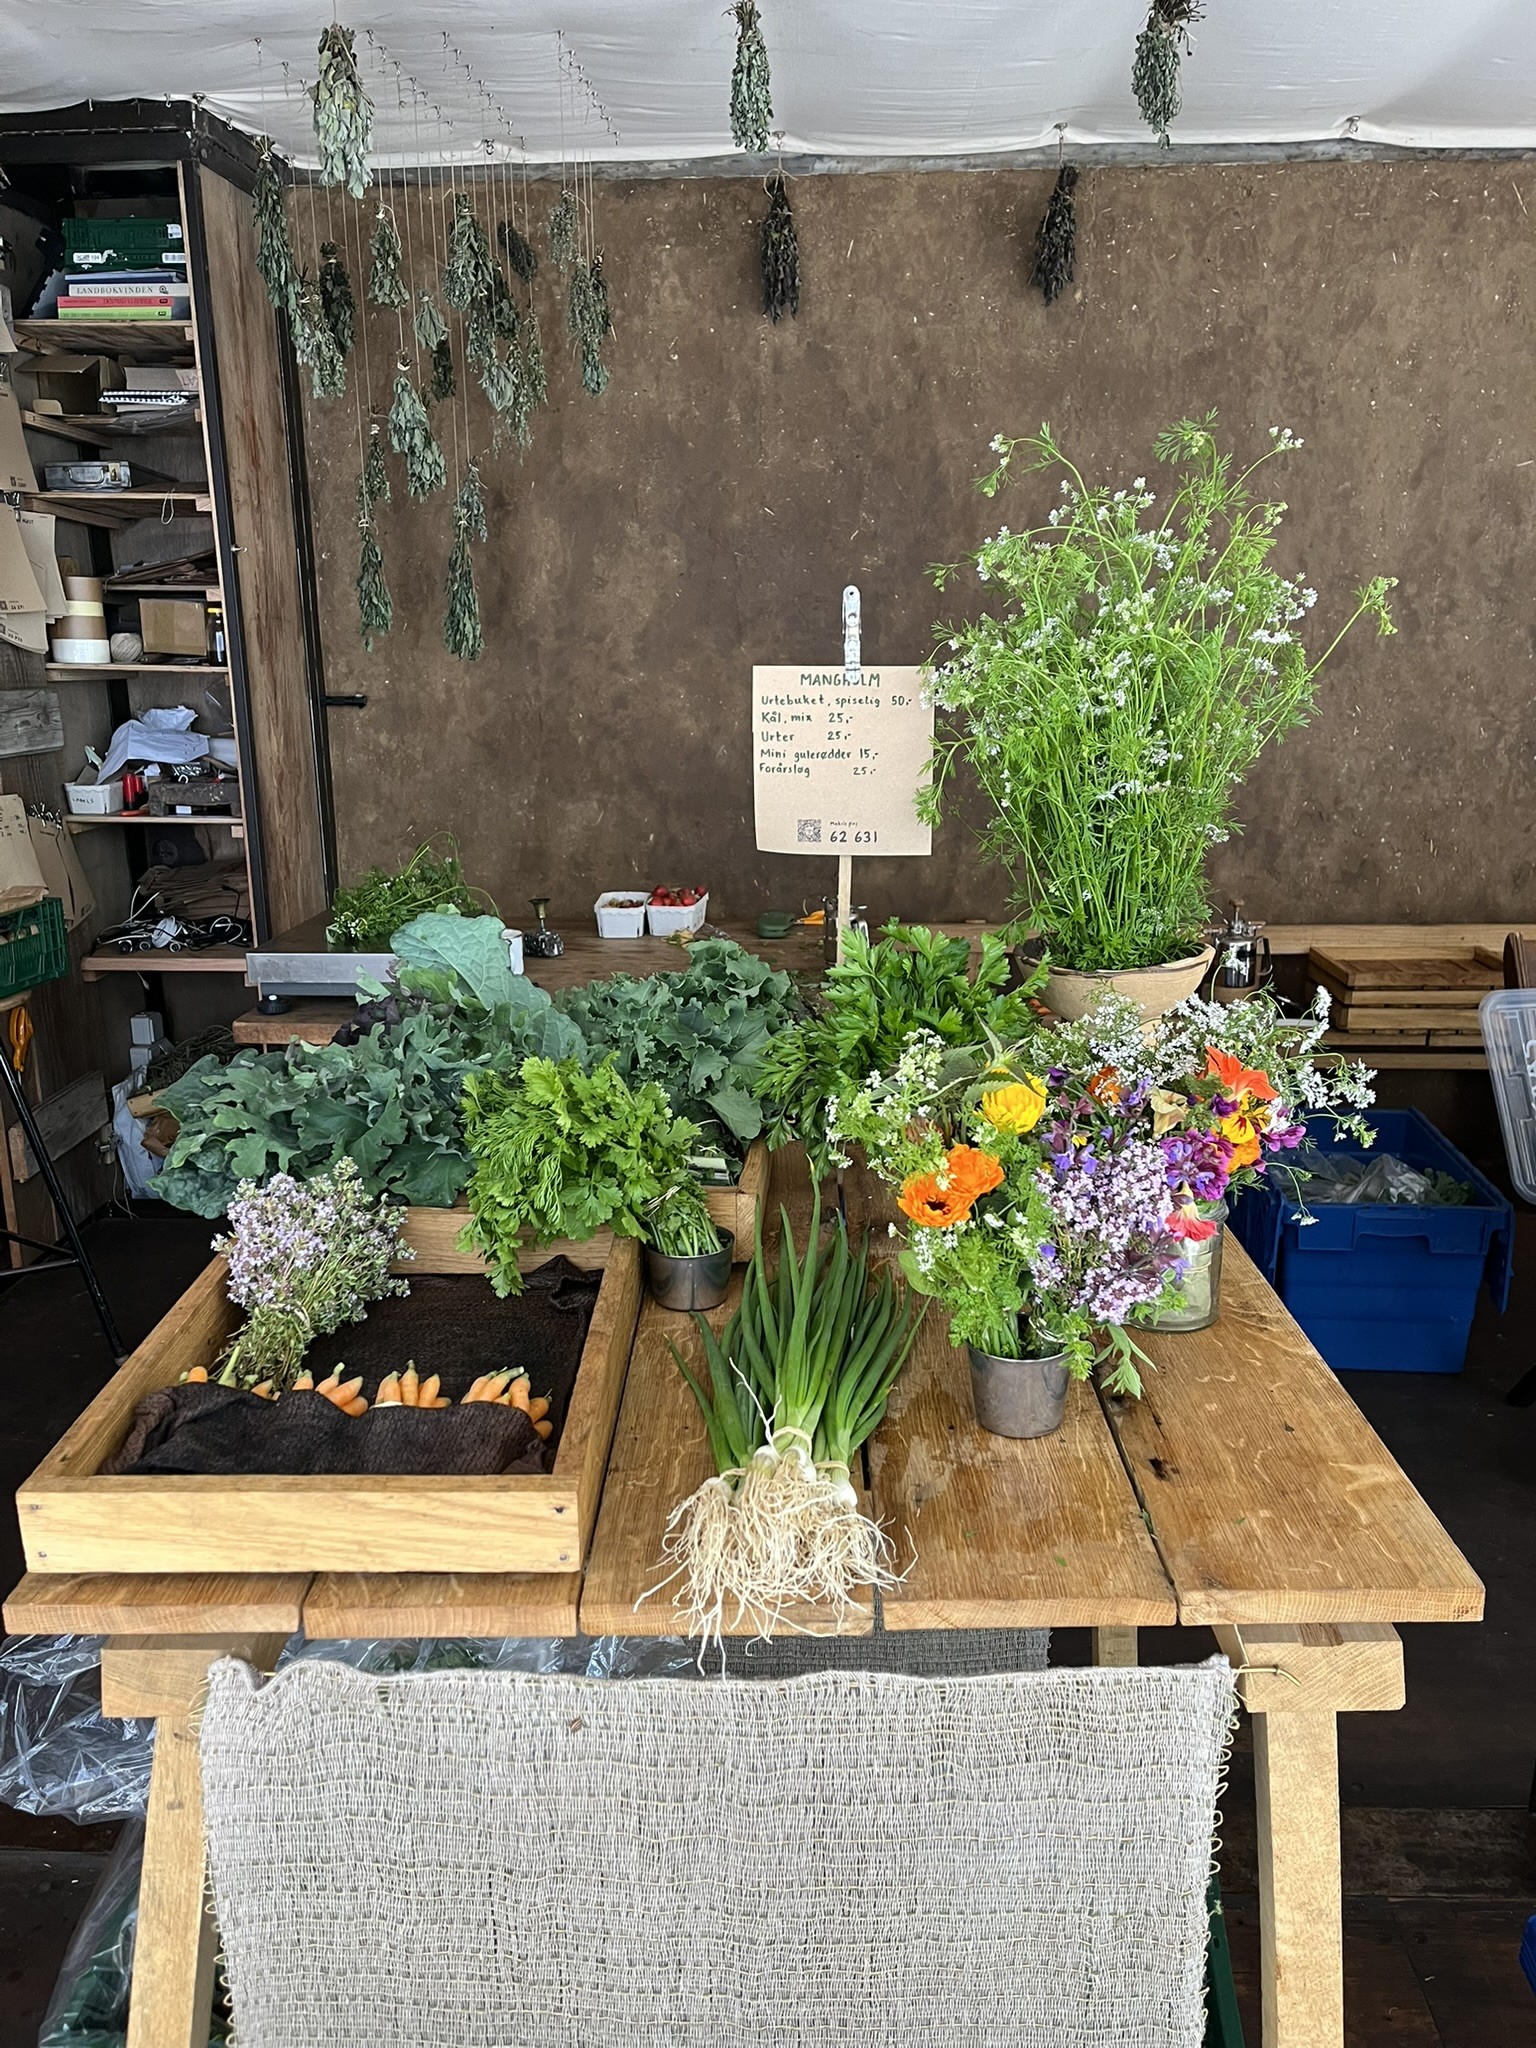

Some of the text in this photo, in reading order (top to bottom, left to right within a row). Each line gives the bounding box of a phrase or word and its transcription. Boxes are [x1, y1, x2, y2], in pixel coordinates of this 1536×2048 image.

[76, 286, 153, 294] LANDBOKVINDEN
[835, 695, 880, 708] spiselig
[791, 712, 812, 722] mix
[761, 731, 795, 742] Urter
[760, 748, 786, 759] Mini
[794, 748, 851, 763] gulerødder
[830, 831, 878, 842] 62 631
